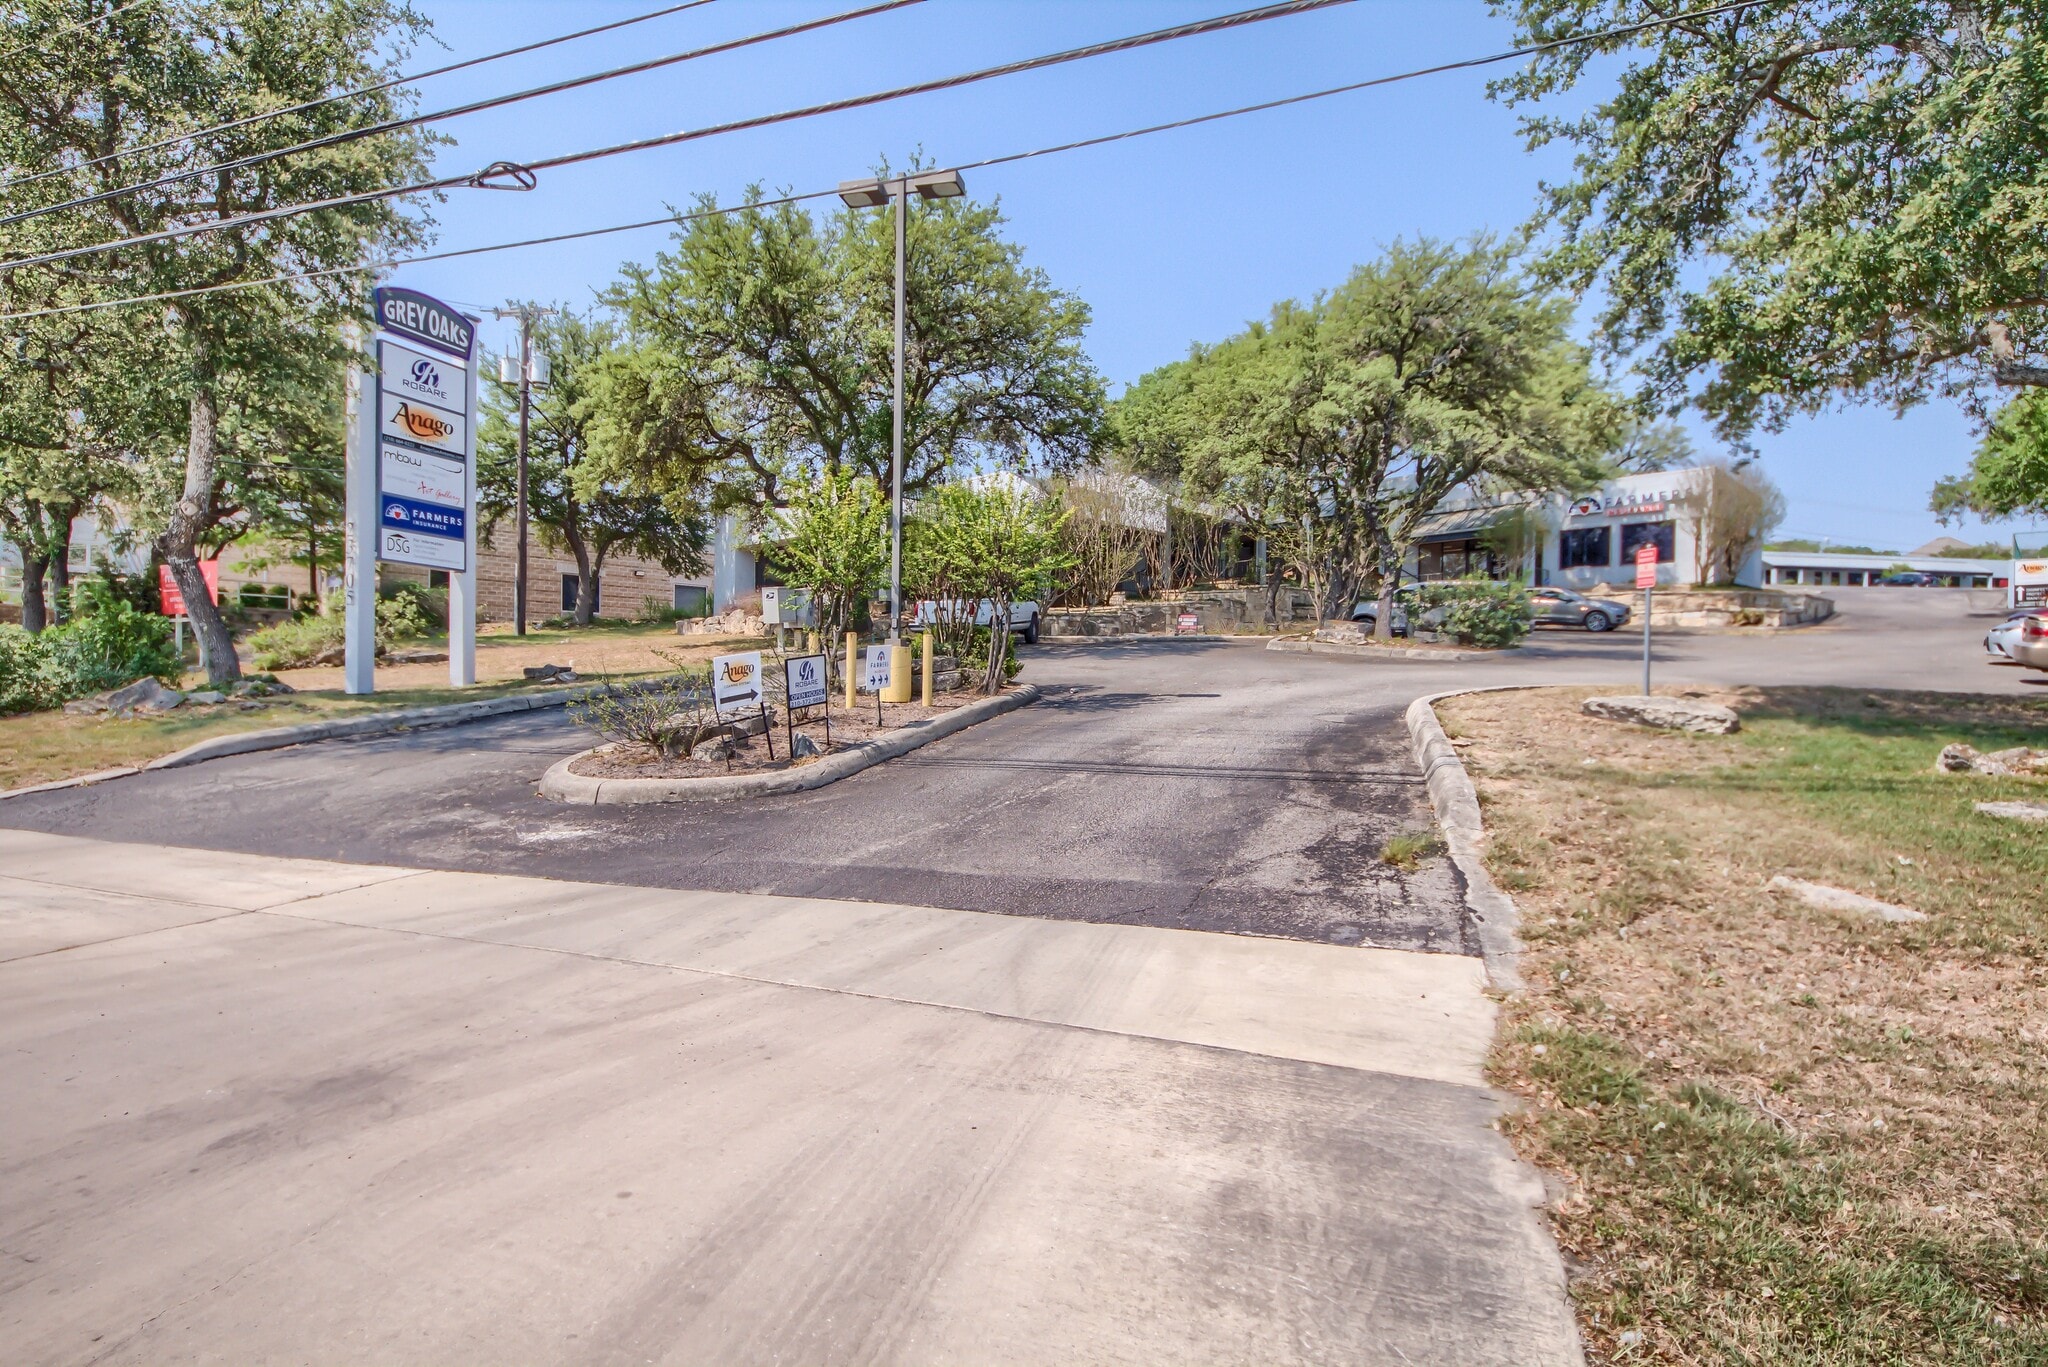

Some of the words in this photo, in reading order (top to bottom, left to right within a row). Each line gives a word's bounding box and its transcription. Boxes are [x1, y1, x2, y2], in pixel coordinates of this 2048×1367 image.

[384, 299, 427, 331] GREY
[428, 309, 469, 347] OAKS
[402, 379, 447, 399] ROBARE
[390, 401, 454, 437] Anago
[412, 509, 463, 526] FARMERS
[412, 520, 447, 530] INSURANCE
[386, 537, 410, 553] DSG
[719, 661, 755, 683] Anago
[794, 679, 819, 689] ROBARE
[791, 693, 807, 701] OPEN
[807, 688, 825, 698] HOUSE
